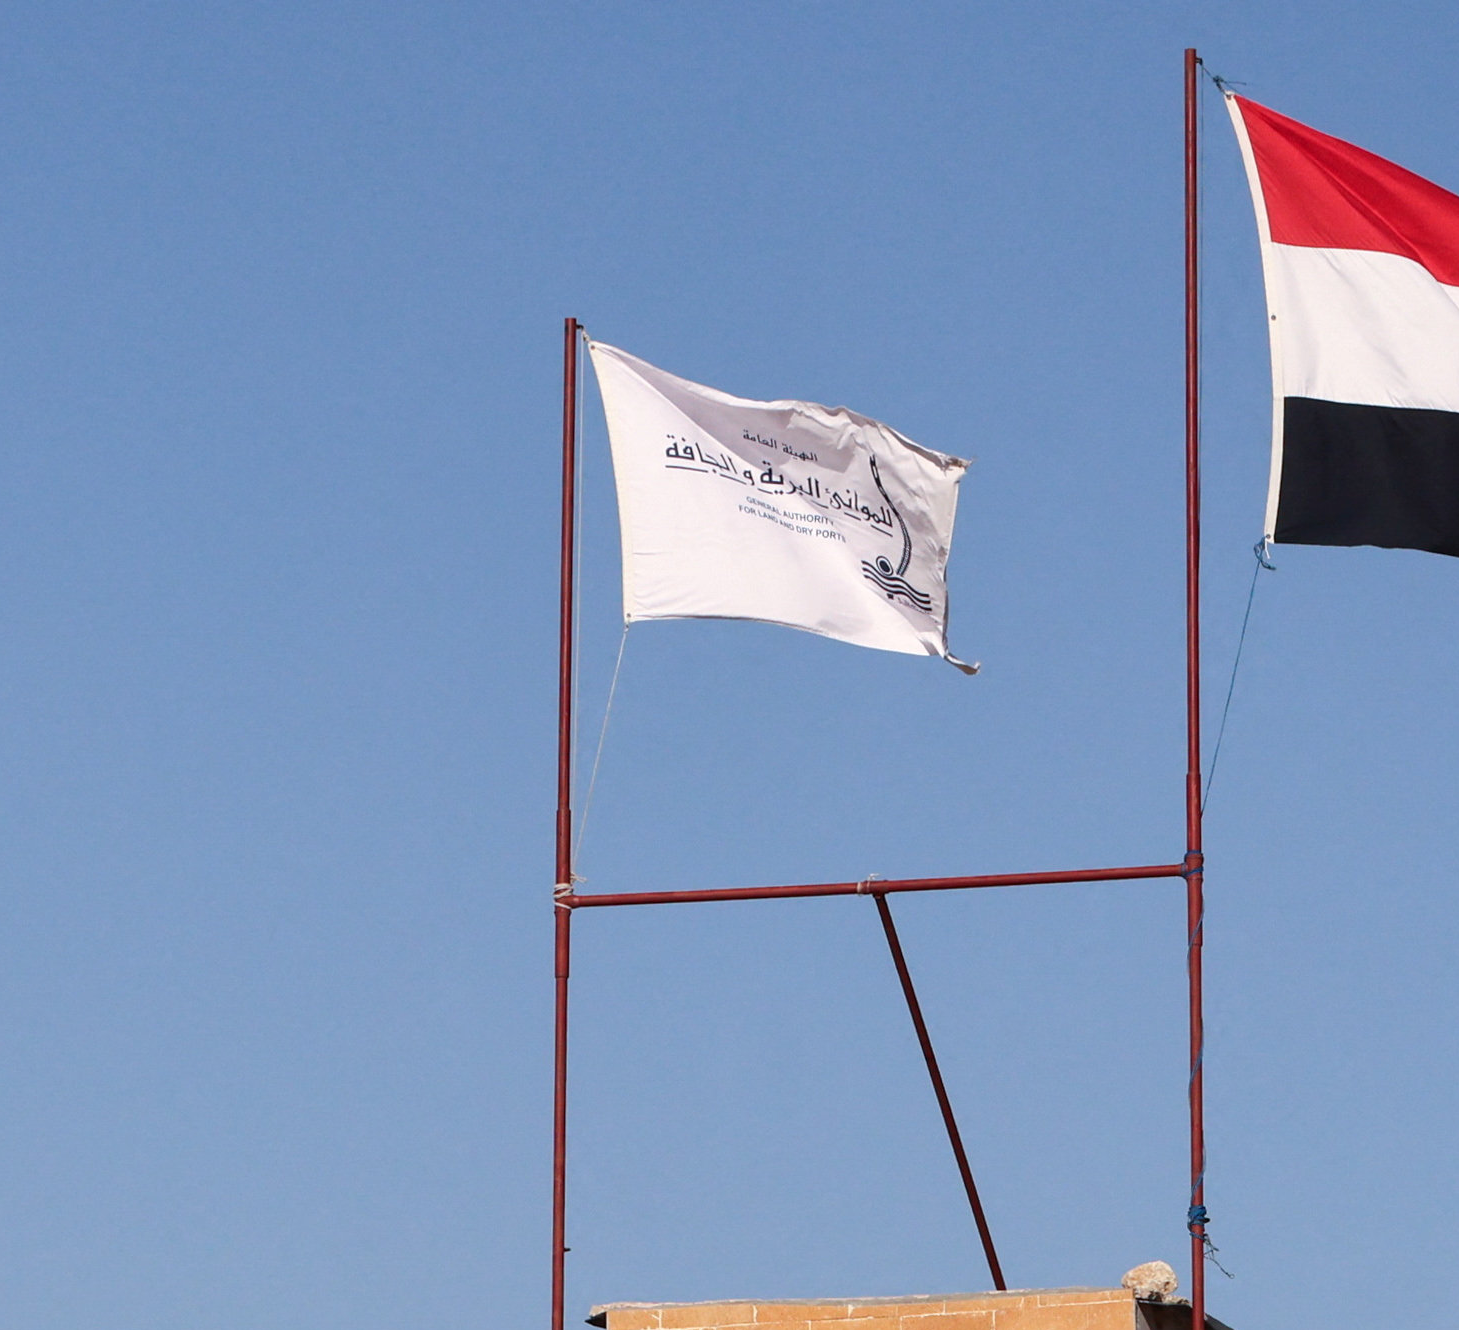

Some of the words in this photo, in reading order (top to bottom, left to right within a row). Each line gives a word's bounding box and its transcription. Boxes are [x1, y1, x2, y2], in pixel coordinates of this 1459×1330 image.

[743, 429, 778, 449] العامة
[782, 442, 818, 462] الهيئة
[760, 459, 820, 498] البرية
[745, 495, 781, 516] GENERAL
[738, 504, 757, 517] FOR
[758, 509, 779, 524] LAND
[779, 519, 795, 532] AND
[796, 525, 814, 537] DRY
